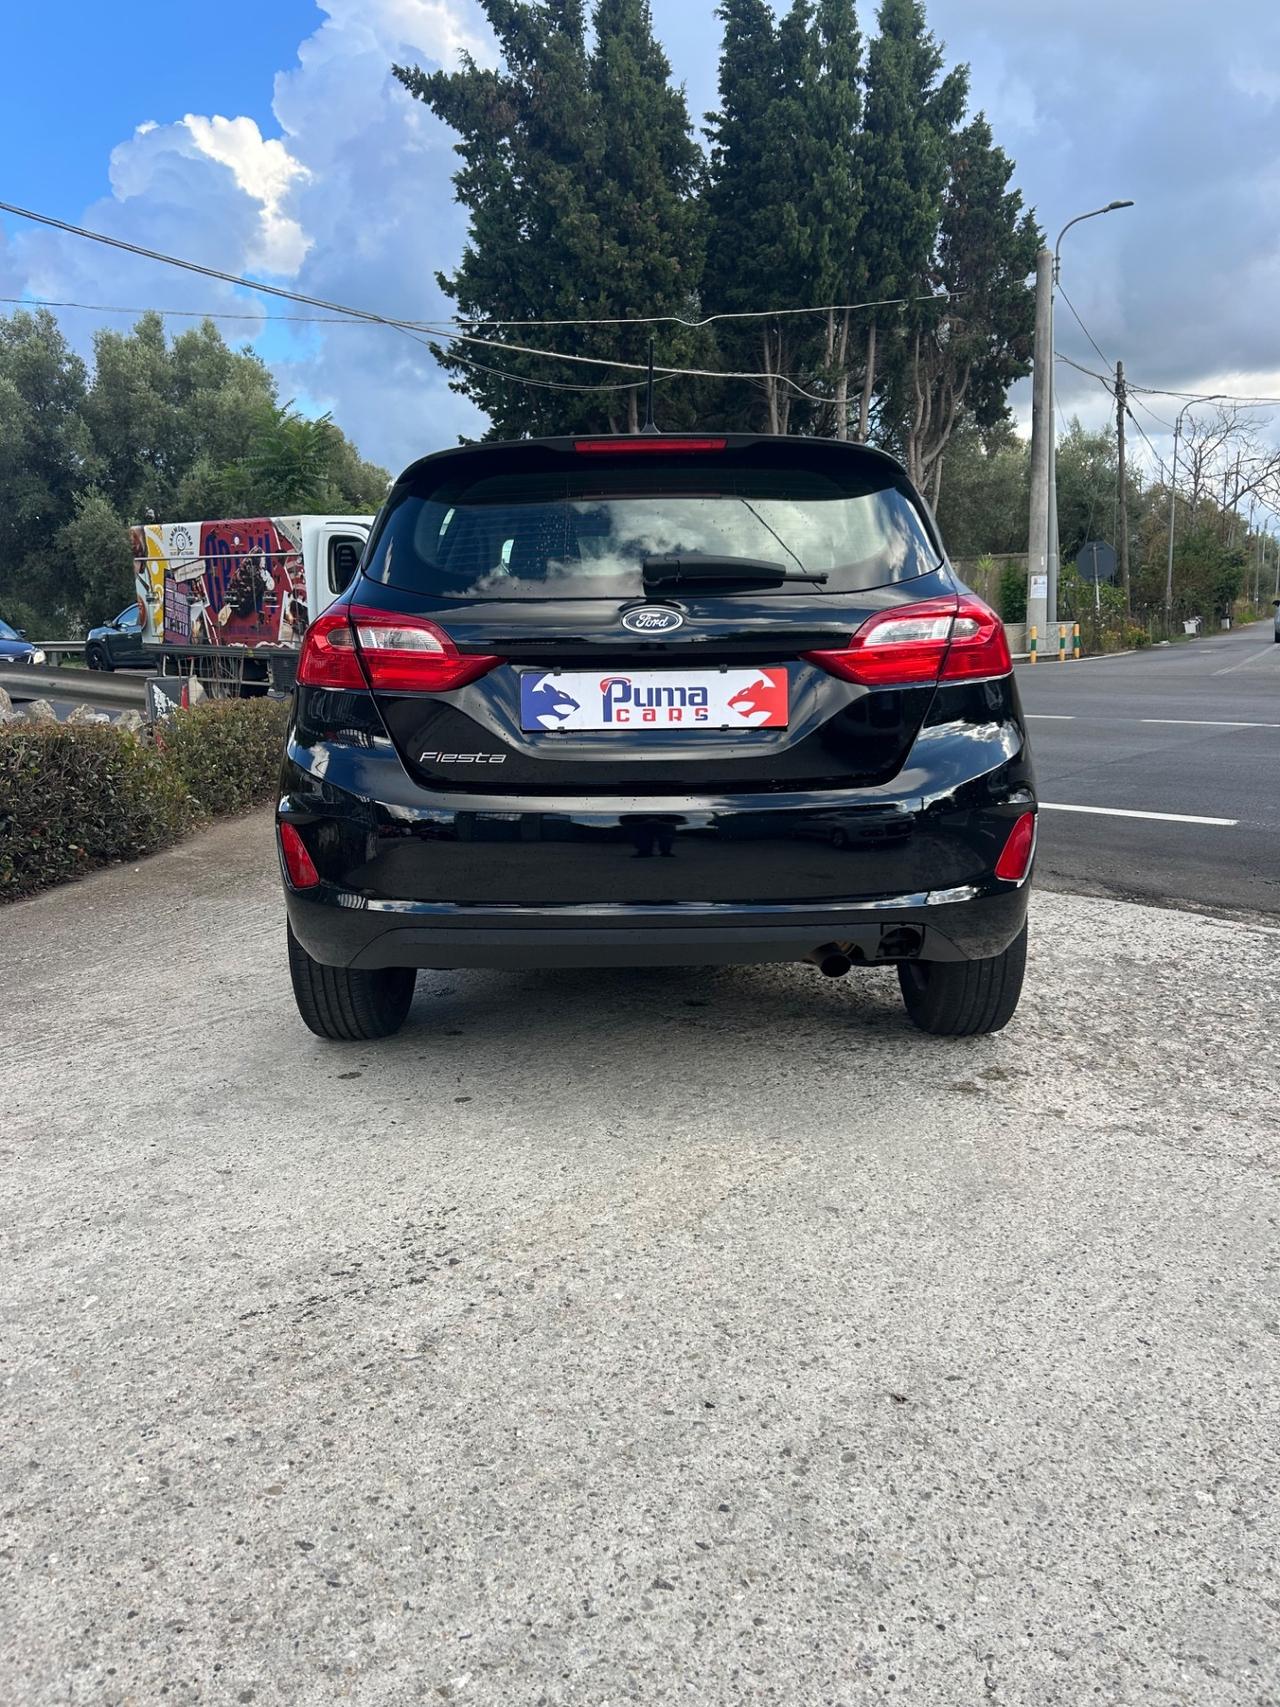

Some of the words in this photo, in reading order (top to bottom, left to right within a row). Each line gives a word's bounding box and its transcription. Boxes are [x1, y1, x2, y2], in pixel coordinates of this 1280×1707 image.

[635, 613, 669, 628] Ford
[600, 677, 708, 722] Puma
[419, 752, 507, 763] Fiesta
